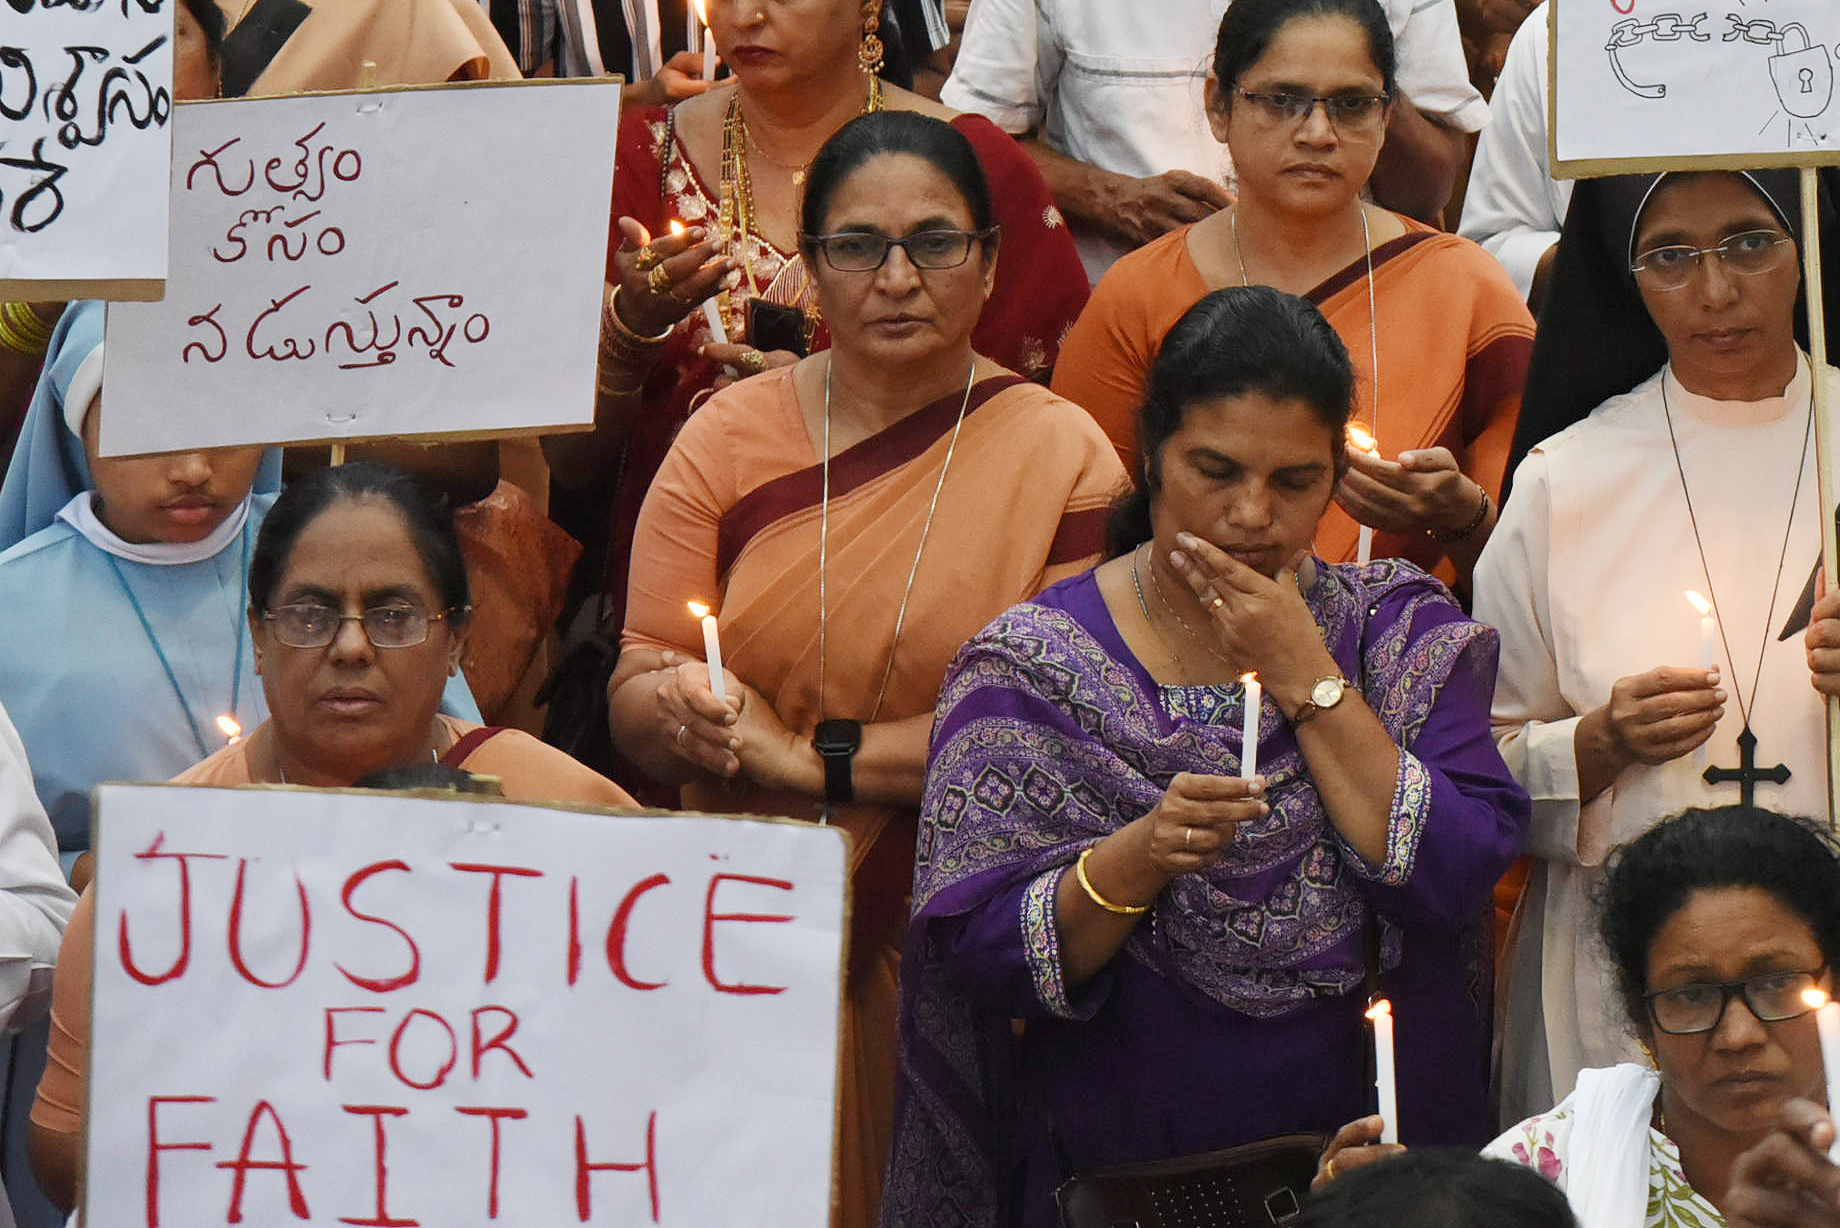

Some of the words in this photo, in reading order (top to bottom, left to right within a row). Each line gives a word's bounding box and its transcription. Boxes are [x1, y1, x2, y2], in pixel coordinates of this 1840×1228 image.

[119, 830, 796, 995] JUSTICE
[323, 1004, 535, 1091] FOR
[146, 1094, 662, 1228] FAITH
